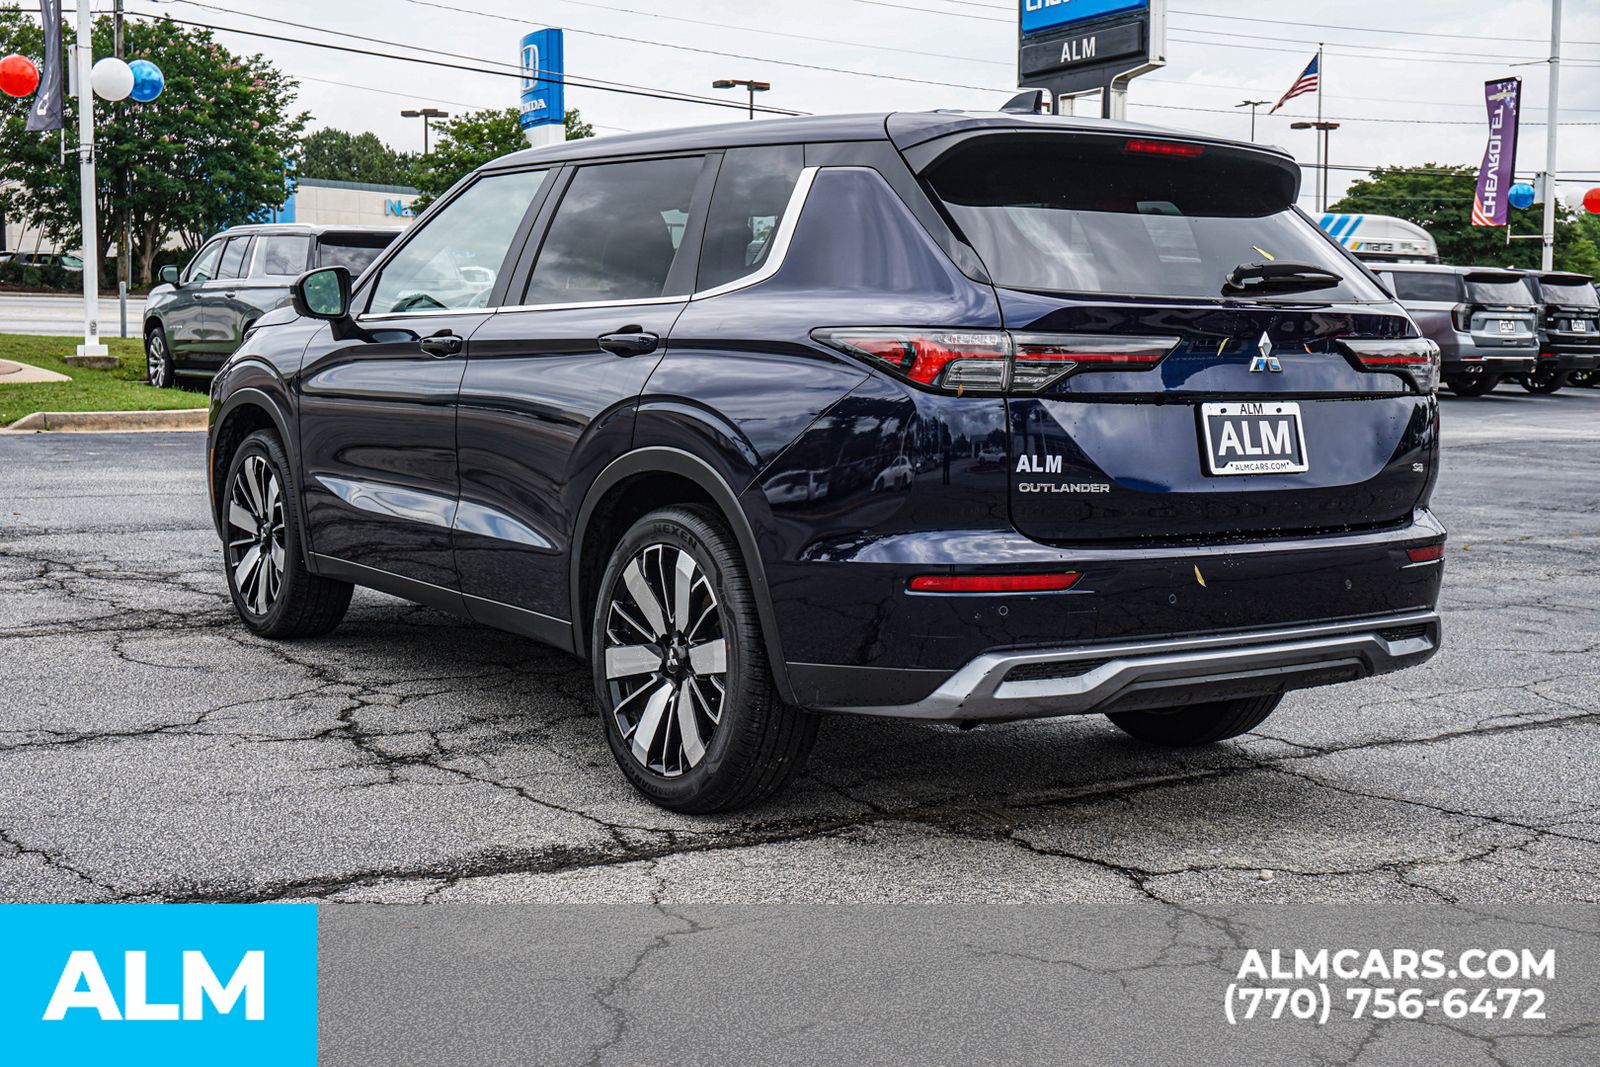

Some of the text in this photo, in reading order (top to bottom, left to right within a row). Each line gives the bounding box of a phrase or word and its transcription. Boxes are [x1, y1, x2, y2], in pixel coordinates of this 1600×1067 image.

[1060, 37, 1096, 63] ALM
[1483, 104, 1504, 218] CHEVROLET
[1240, 403, 1264, 415] ALM
[1218, 420, 1292, 456] ALM
[1015, 454, 1062, 473] ALM
[1235, 462, 1287, 472] ALMCARS.COM
[1018, 482, 1111, 494] OUTLANDER
[652, 523, 698, 551] NEXEN
